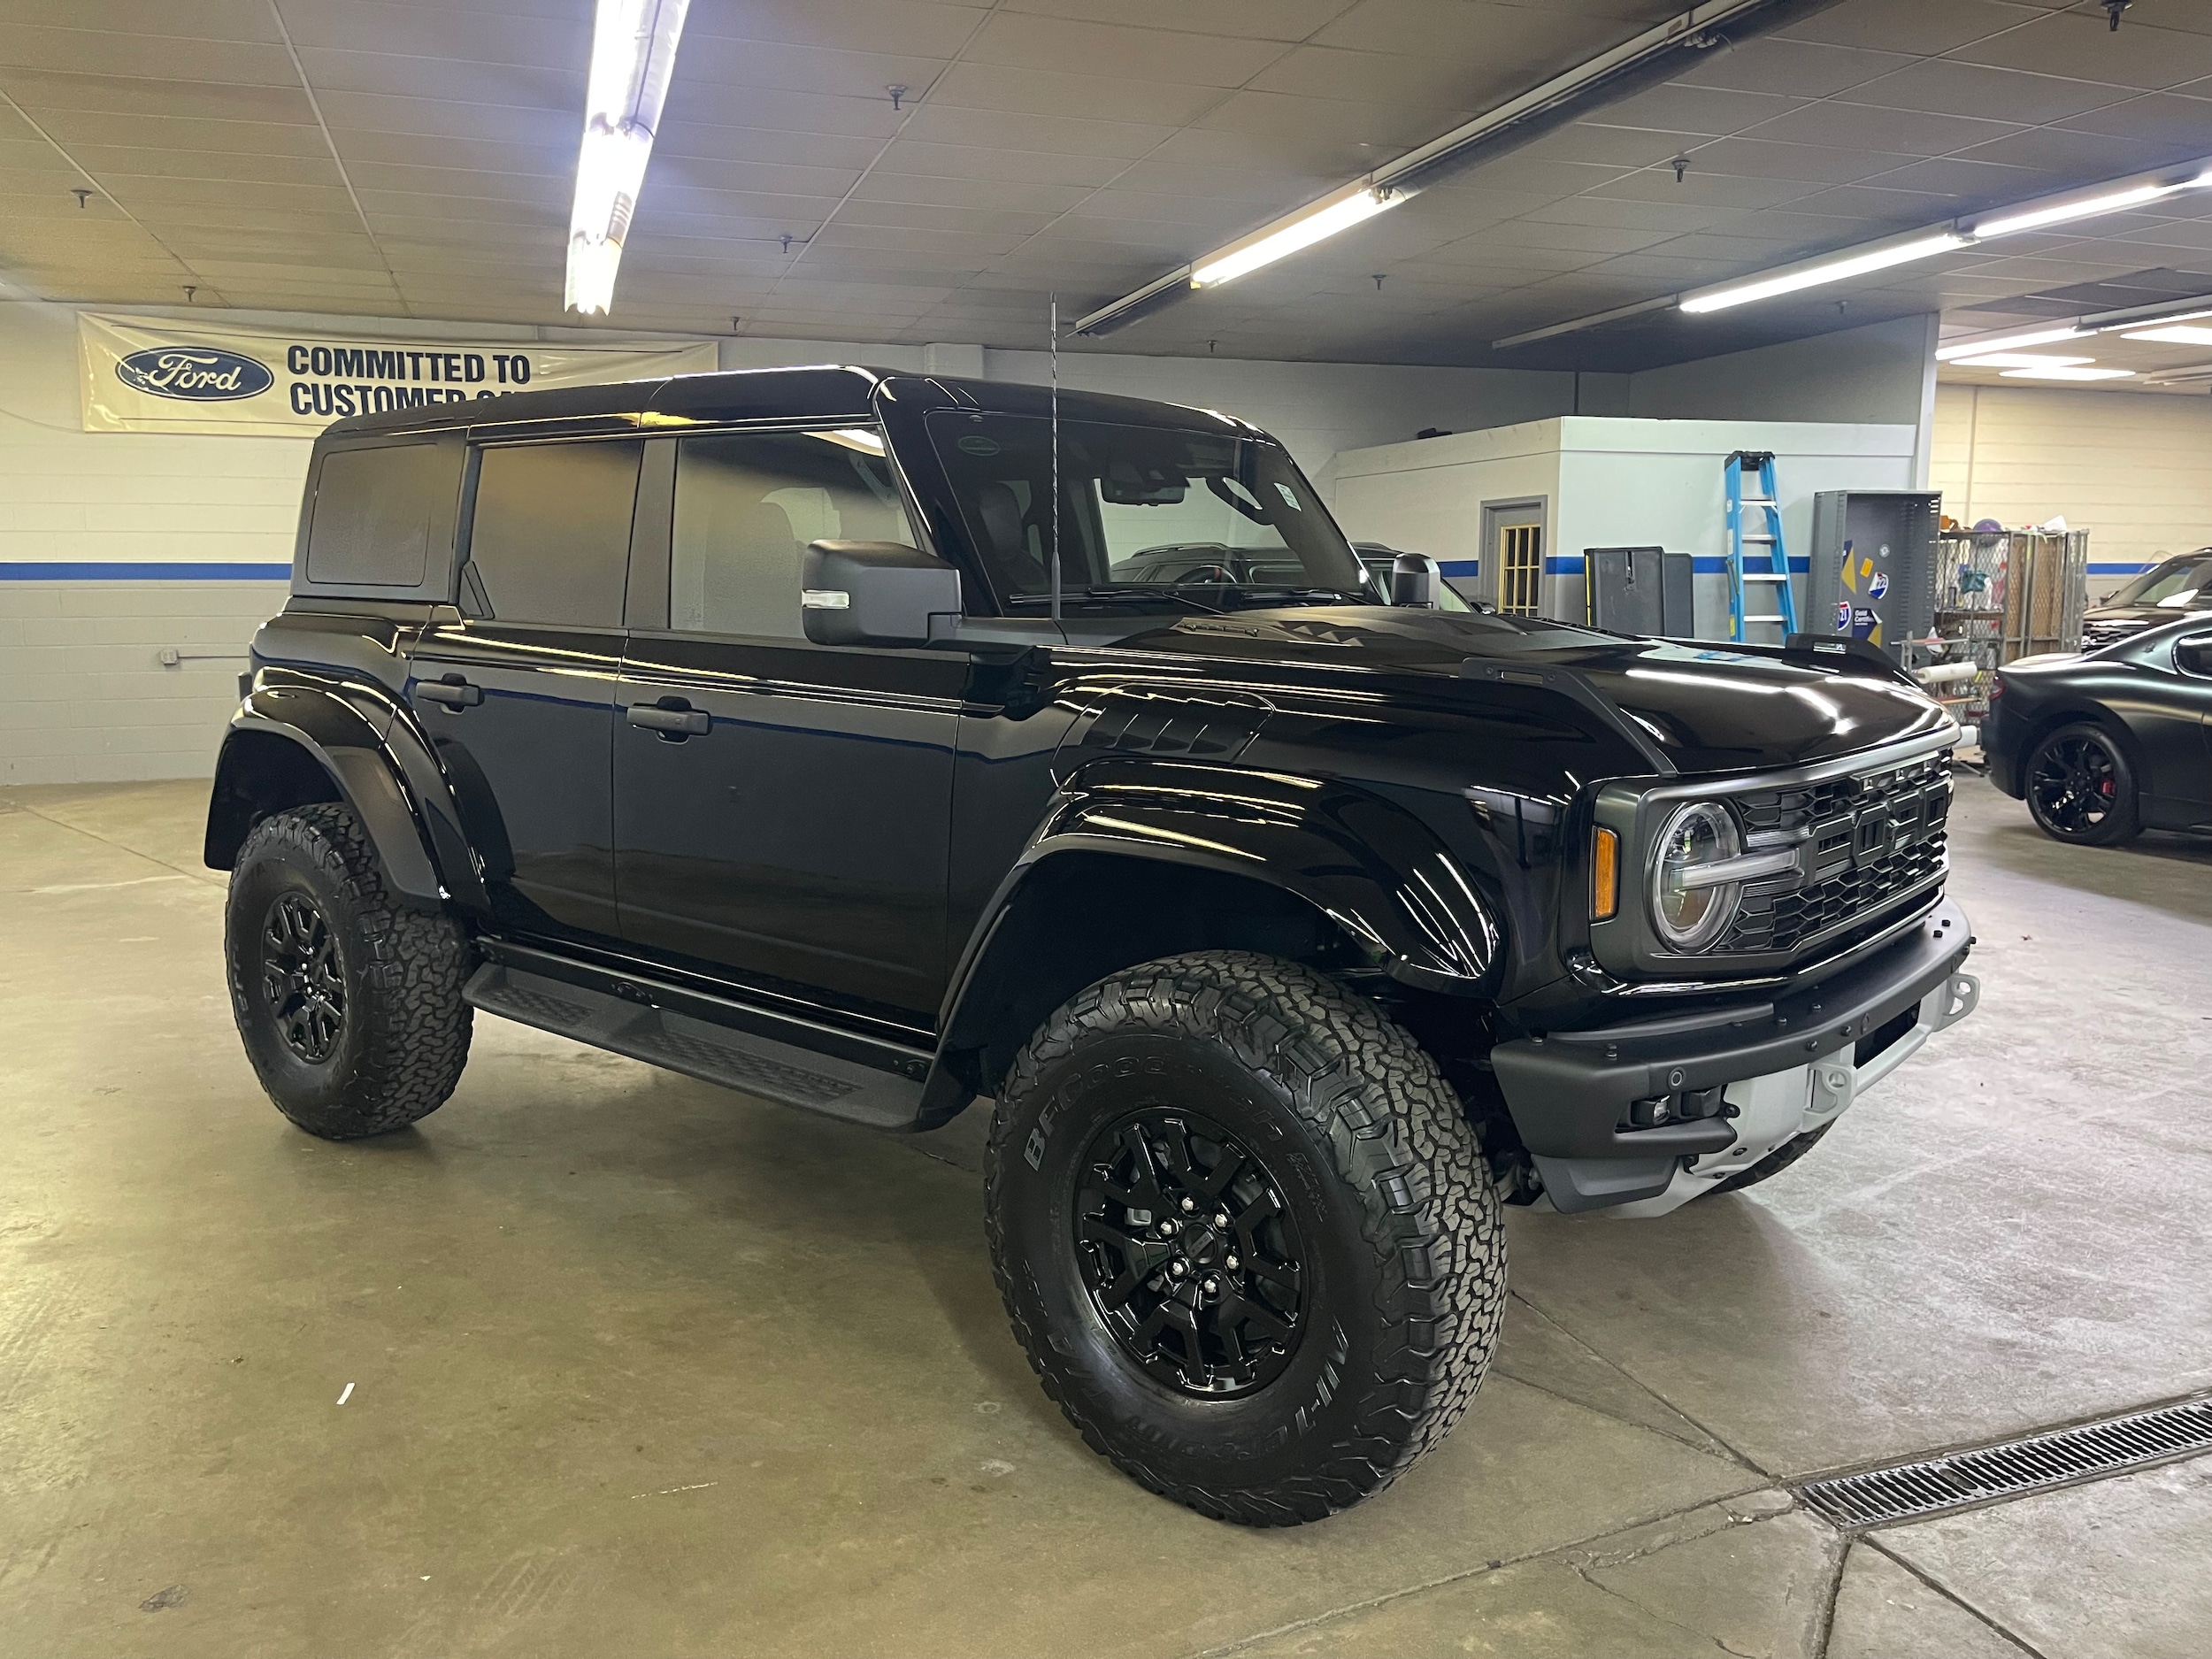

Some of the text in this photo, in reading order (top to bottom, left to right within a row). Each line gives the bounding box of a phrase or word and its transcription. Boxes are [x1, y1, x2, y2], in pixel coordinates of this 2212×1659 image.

[148, 353, 242, 391] Ford
[288, 345, 531, 385] COMMITTED TO
[1808, 780, 1949, 885] FORD
